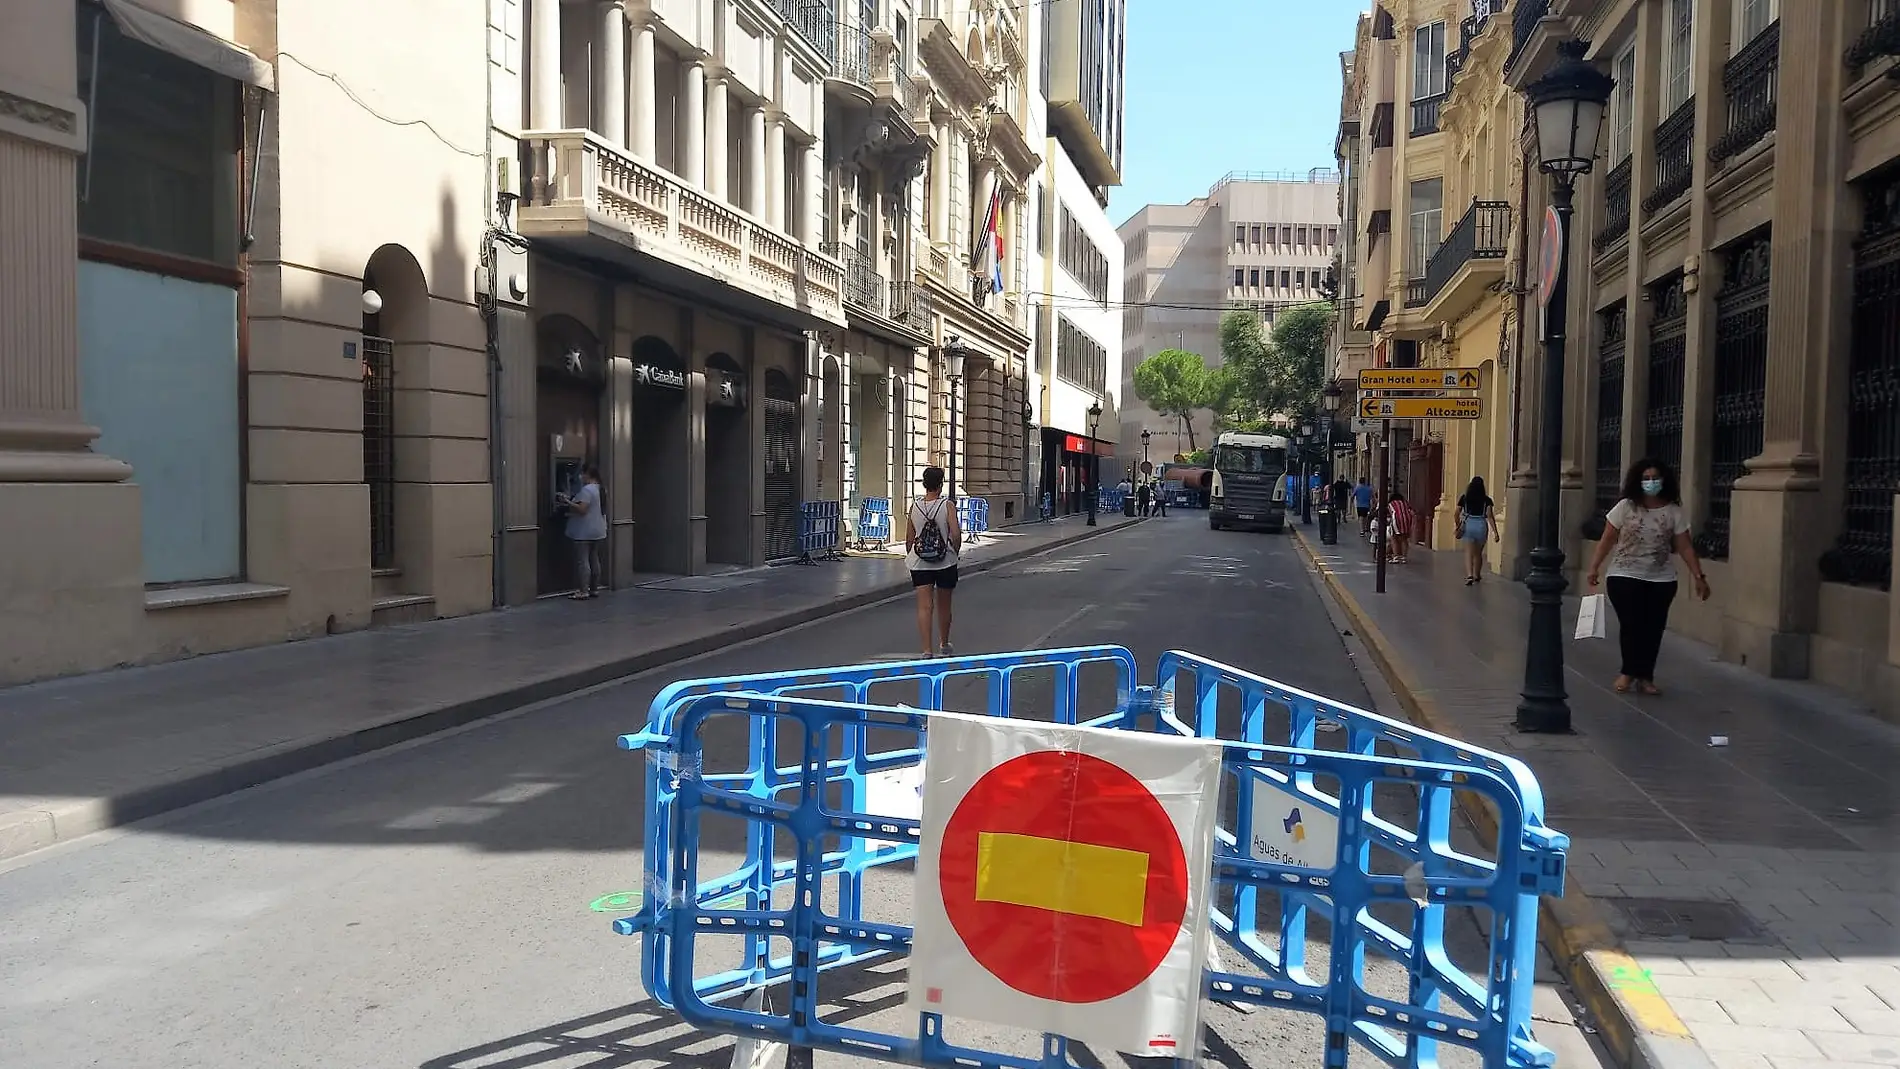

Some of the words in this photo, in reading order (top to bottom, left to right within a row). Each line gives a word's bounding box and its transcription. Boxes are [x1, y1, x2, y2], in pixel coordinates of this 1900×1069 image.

[650, 366, 684, 385] CaixaBank
[1361, 376, 1384, 384] Gran
[1387, 376, 1415, 384] Hotel
[1425, 407, 1478, 417] Altozano
[1253, 834, 1280, 860] Aguas
[1282, 851, 1294, 865] de
